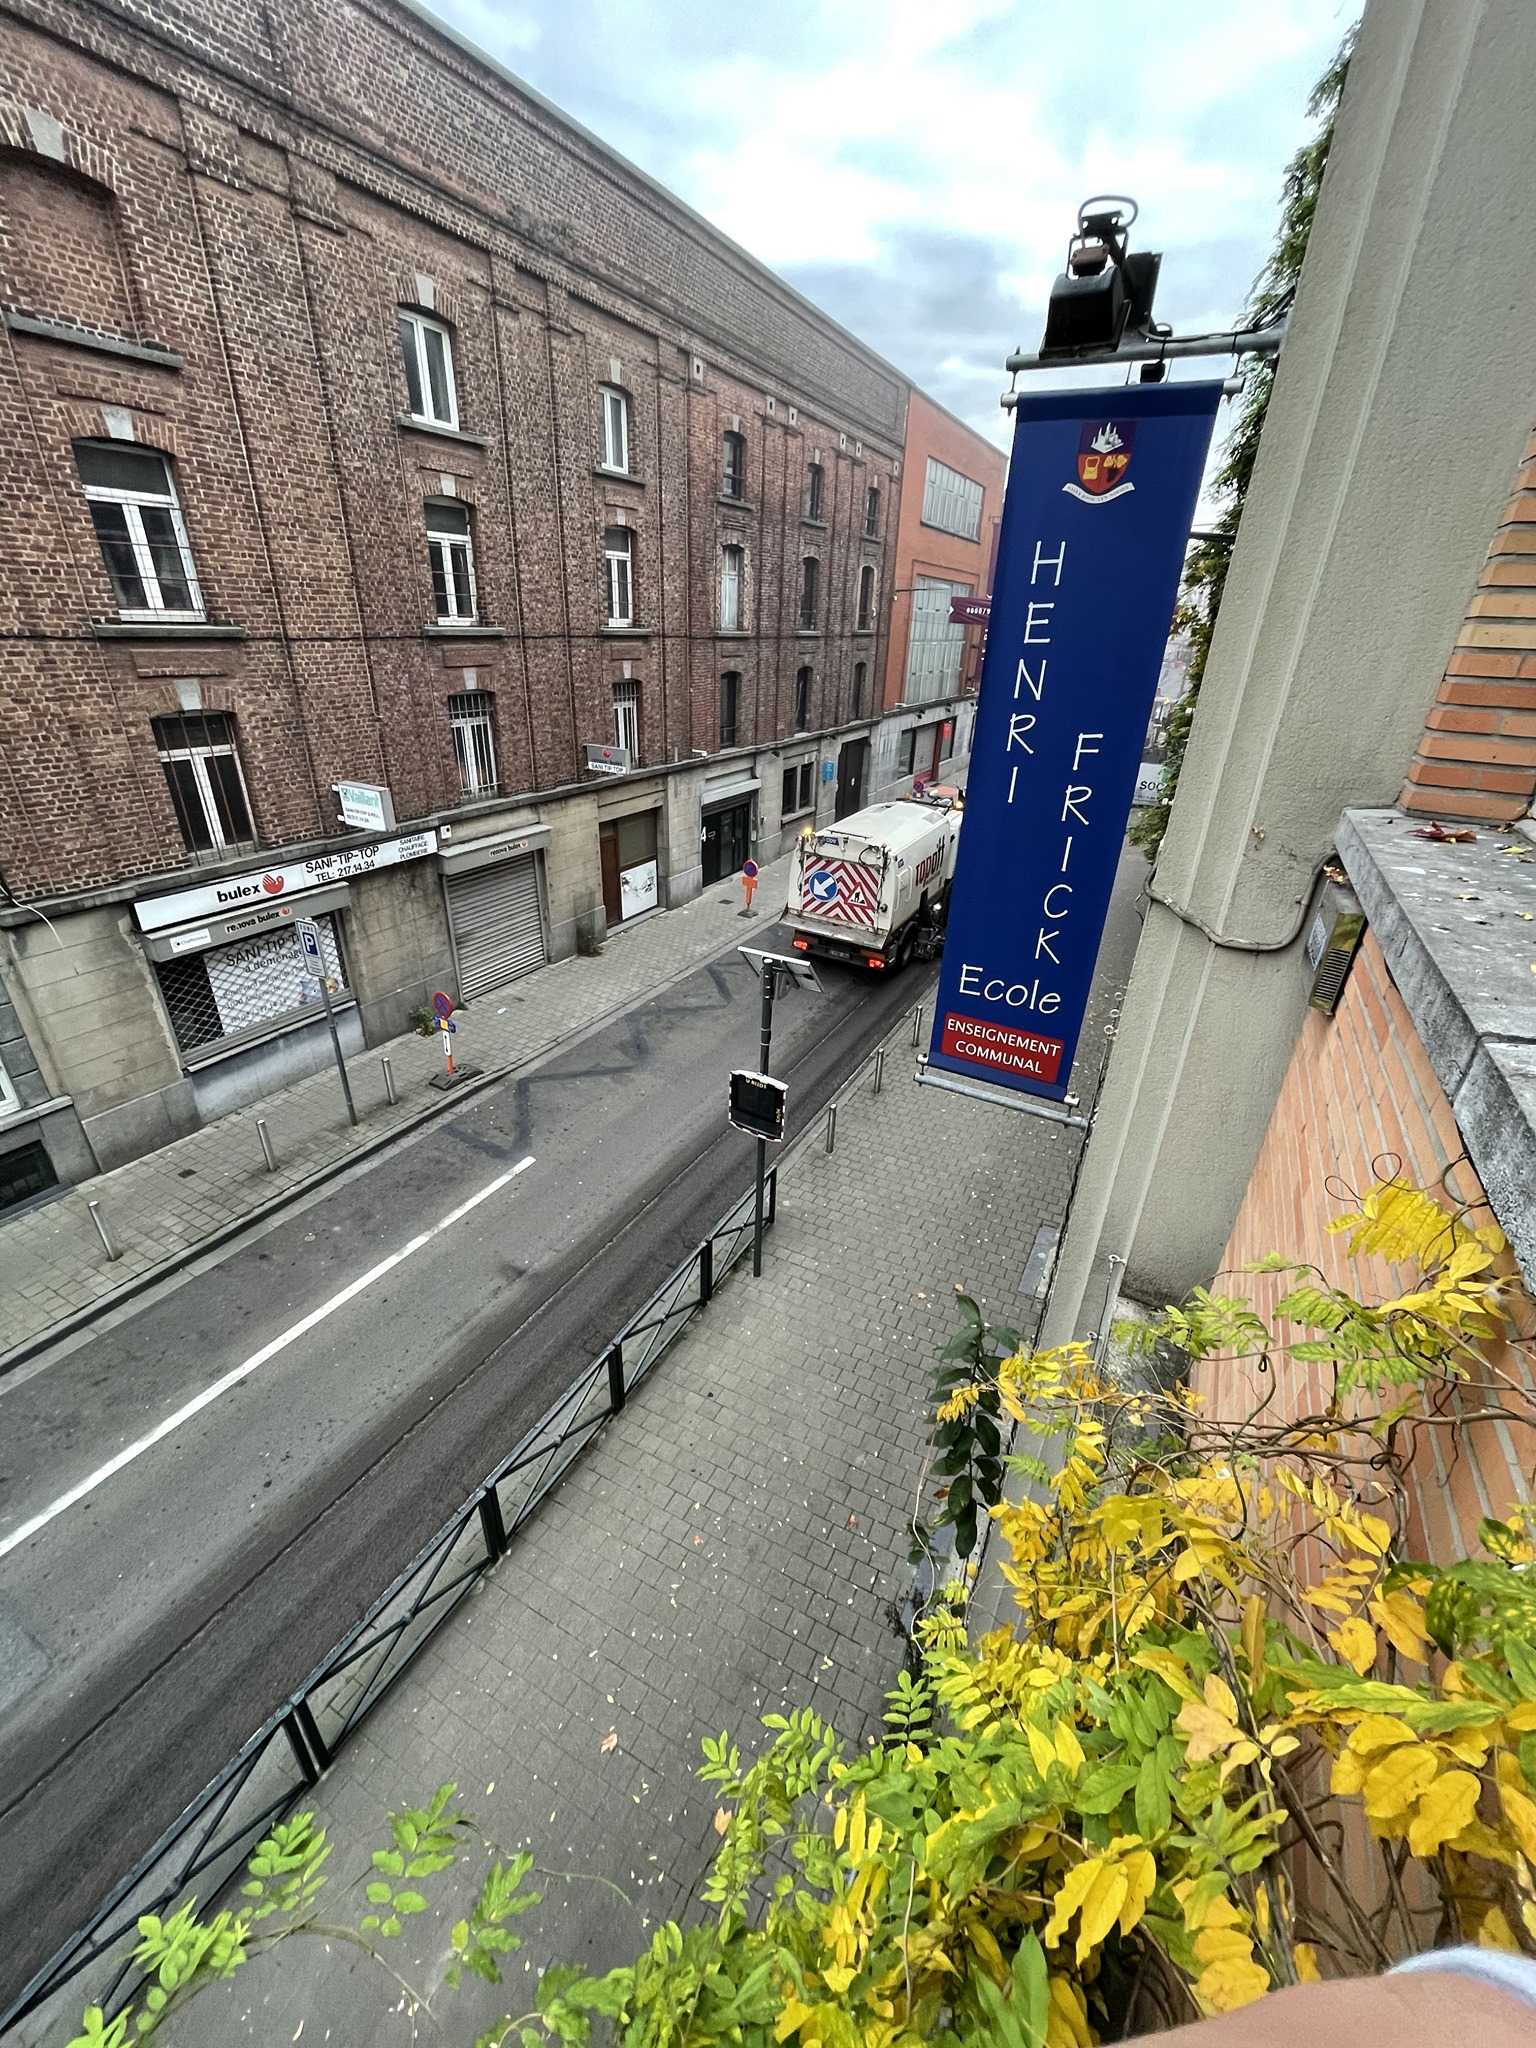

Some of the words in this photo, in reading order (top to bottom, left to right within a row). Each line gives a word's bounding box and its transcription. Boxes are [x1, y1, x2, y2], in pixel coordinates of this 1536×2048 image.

[1006, 540, 1066, 804] HENRI
[305, 845, 380, 874] SANI-TIP-TOP
[1035, 732, 1104, 964] FRICK
[337, 860, 376, 877] 217.14.34
[216, 882, 262, 903] bulex
[257, 909, 280, 924] bulex
[226, 945, 262, 967] SANI
[264, 937, 286, 954] TIP
[959, 963, 1062, 1014] Ecole
[947, 1018, 1062, 1057] ENSEIGNEMENT
[955, 1040, 1043, 1074] COMMUNAL
